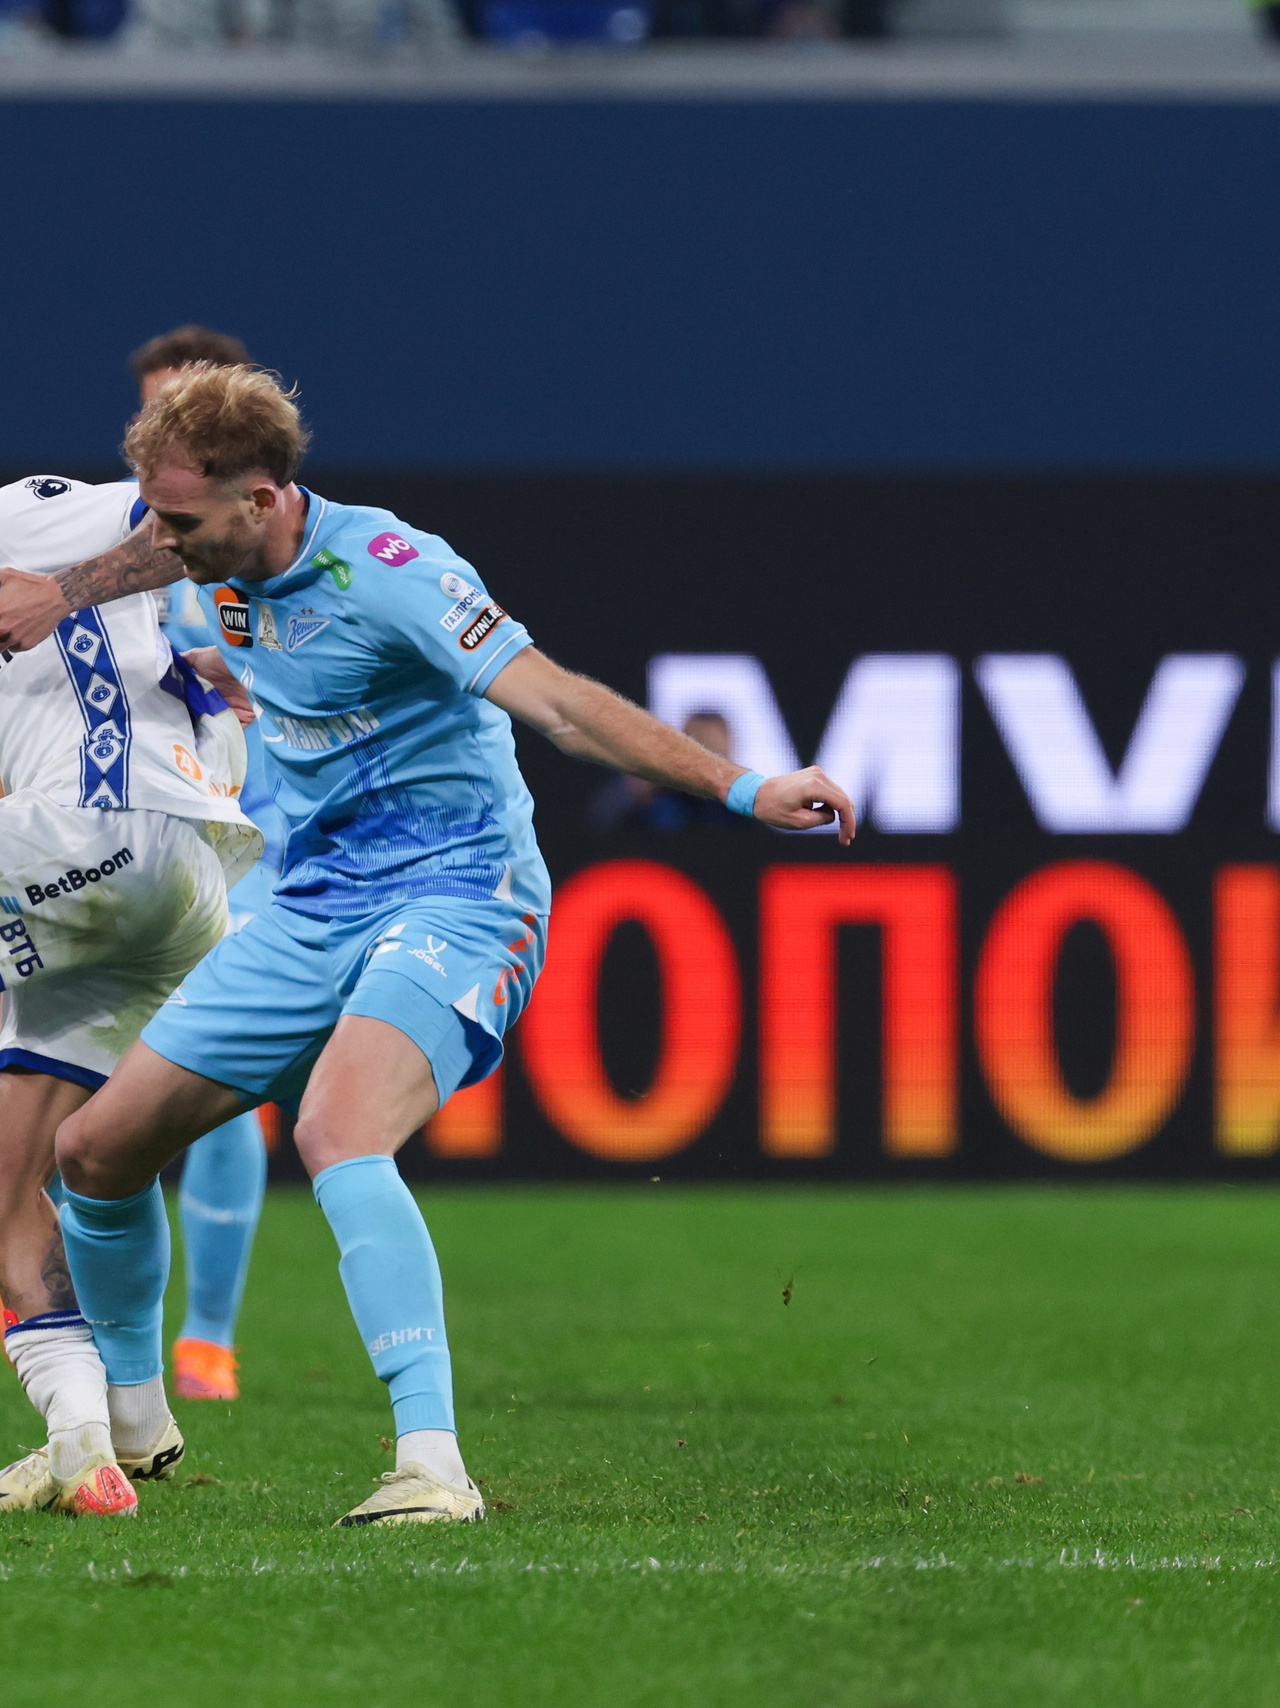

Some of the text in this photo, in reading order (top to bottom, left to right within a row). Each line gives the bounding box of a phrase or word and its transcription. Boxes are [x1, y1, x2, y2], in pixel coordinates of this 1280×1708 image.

[222, 609, 247, 629] WIN
[646, 650, 1280, 835] MV
[24, 846, 135, 907] BetBoom
[370, 1326, 437, 1358] ЗЕНИТ
